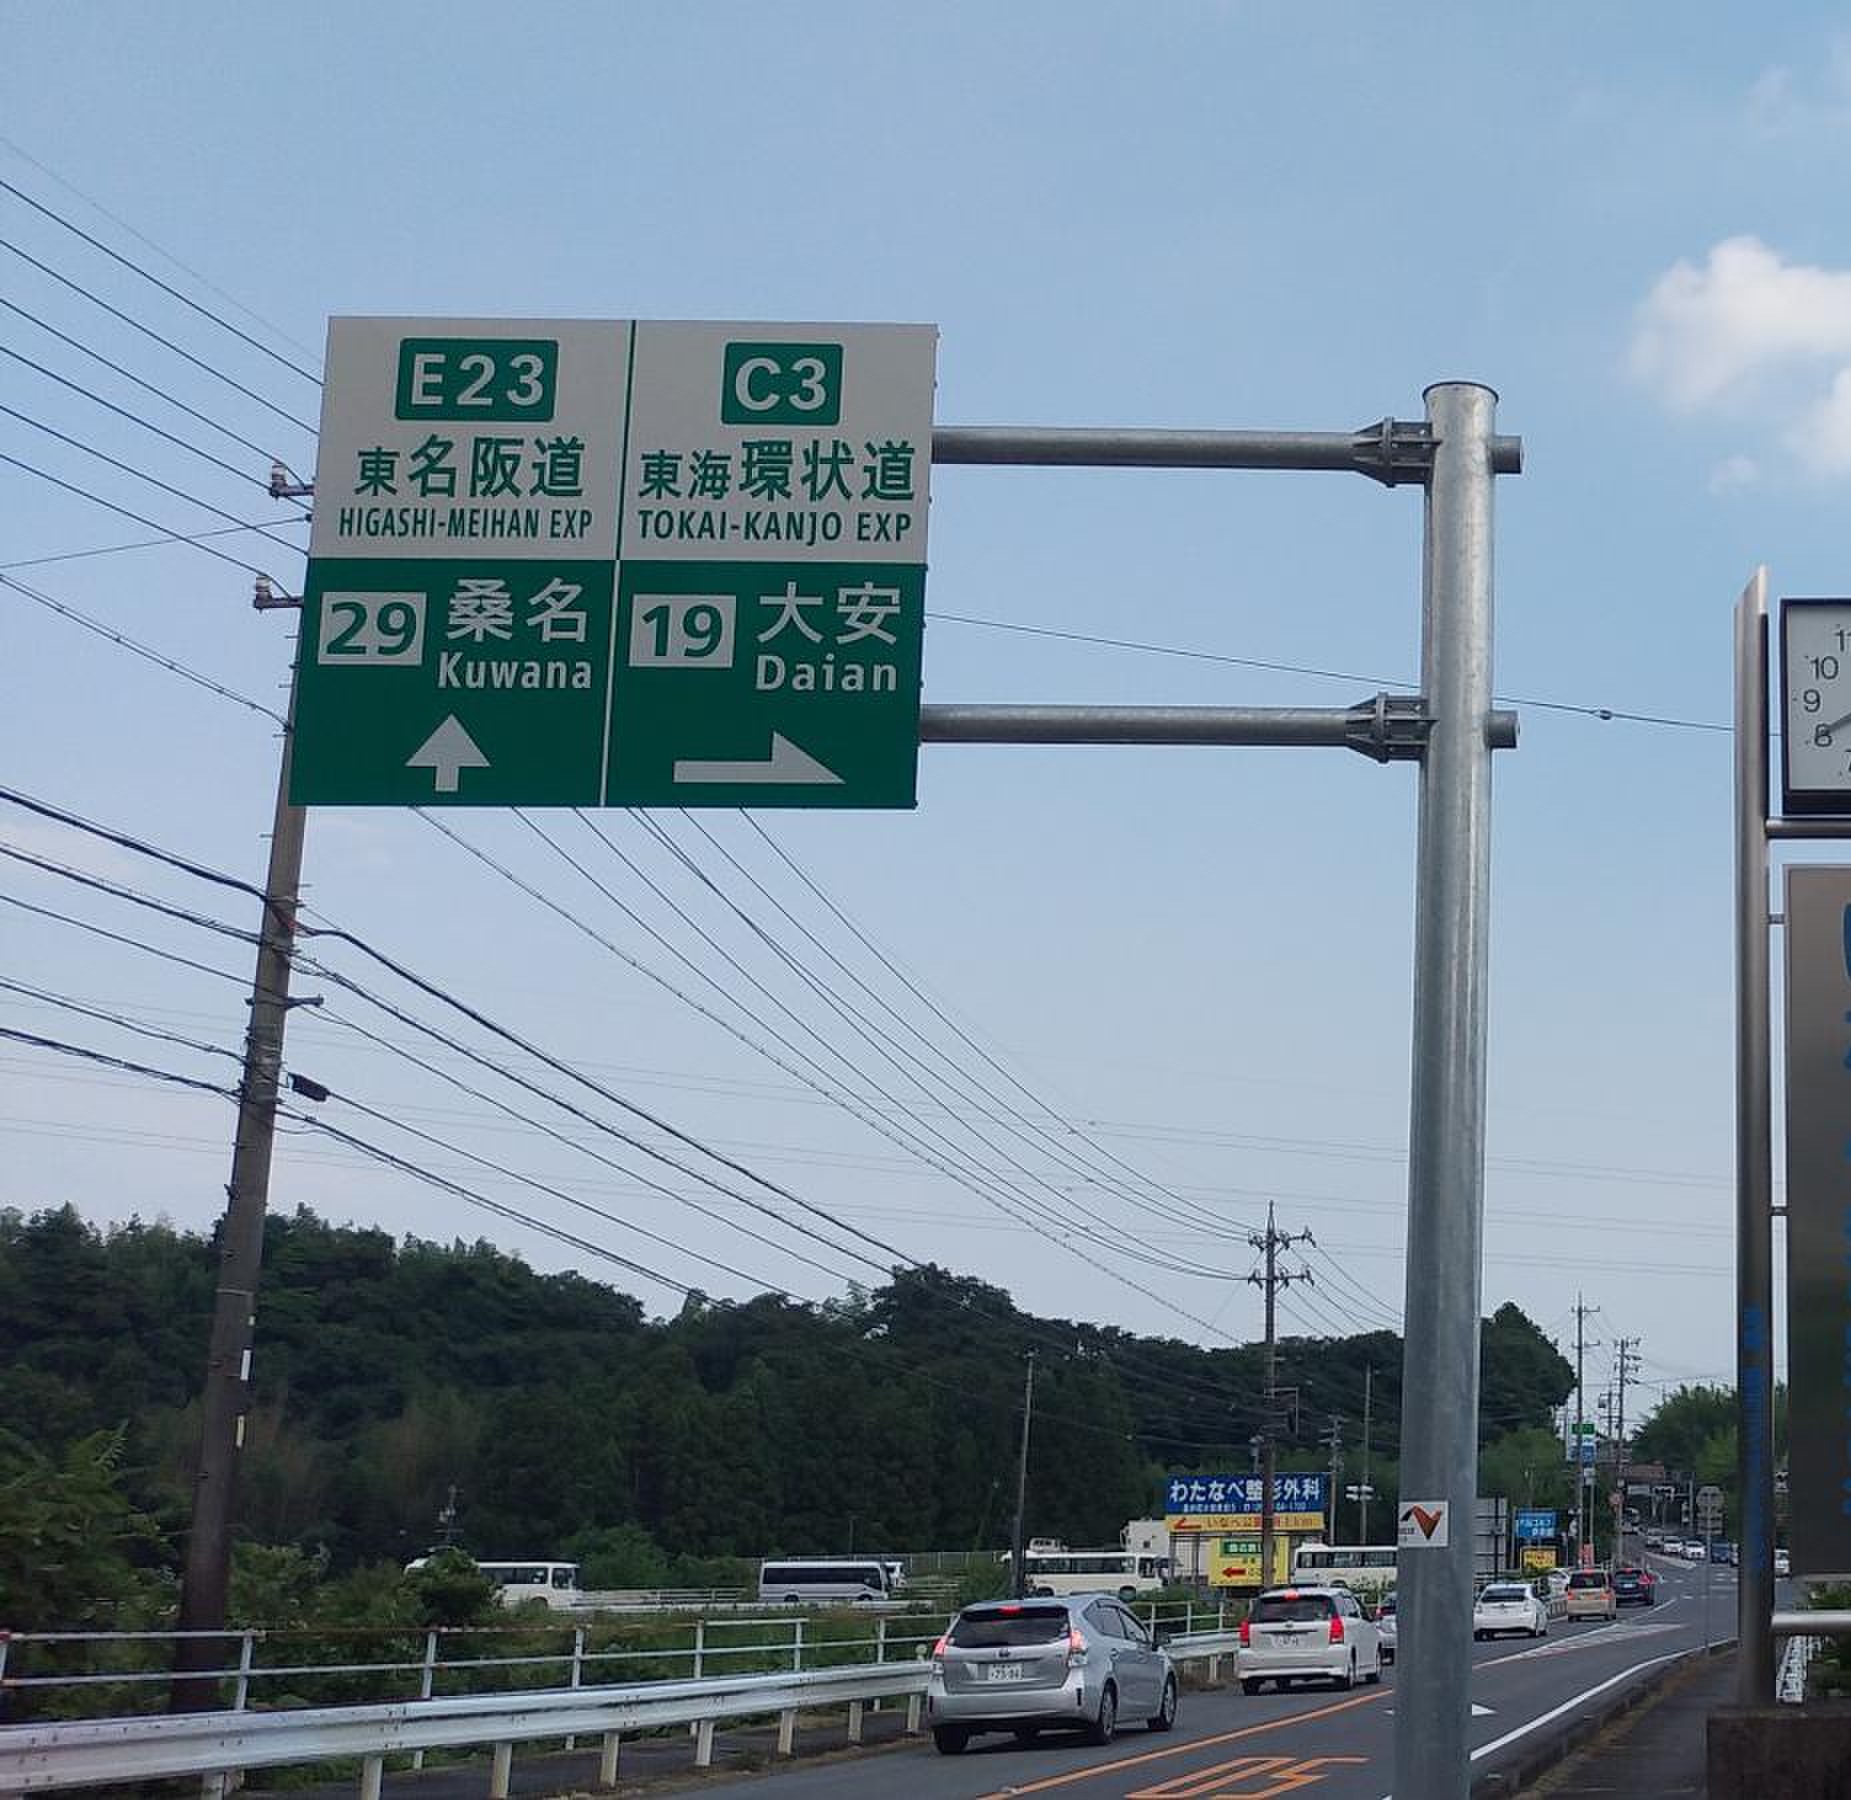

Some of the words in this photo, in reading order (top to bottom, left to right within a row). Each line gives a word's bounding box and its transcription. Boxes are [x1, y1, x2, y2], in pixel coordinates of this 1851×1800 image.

[410, 353, 544, 406] E23
[734, 357, 828, 411] C3
[356, 435, 586, 499] 東名阪道
[639, 439, 916, 502] 東海環状道
[338, 507, 540, 538] HIGASHI-MEIHAN
[550, 510, 592, 539] EXP
[639, 510, 842, 546] TOKAI-KANJO
[857, 512, 912, 542] EXP
[326, 601, 418, 657] 29
[446, 577, 589, 643] 桑名
[641, 603, 723, 658] 19
[756, 582, 901, 646] 大安
[438, 652, 592, 690] Kuwana
[755, 655, 898, 692] Daian
[1810, 655, 1839, 680] 10
[1803, 688, 1821, 713] 9
